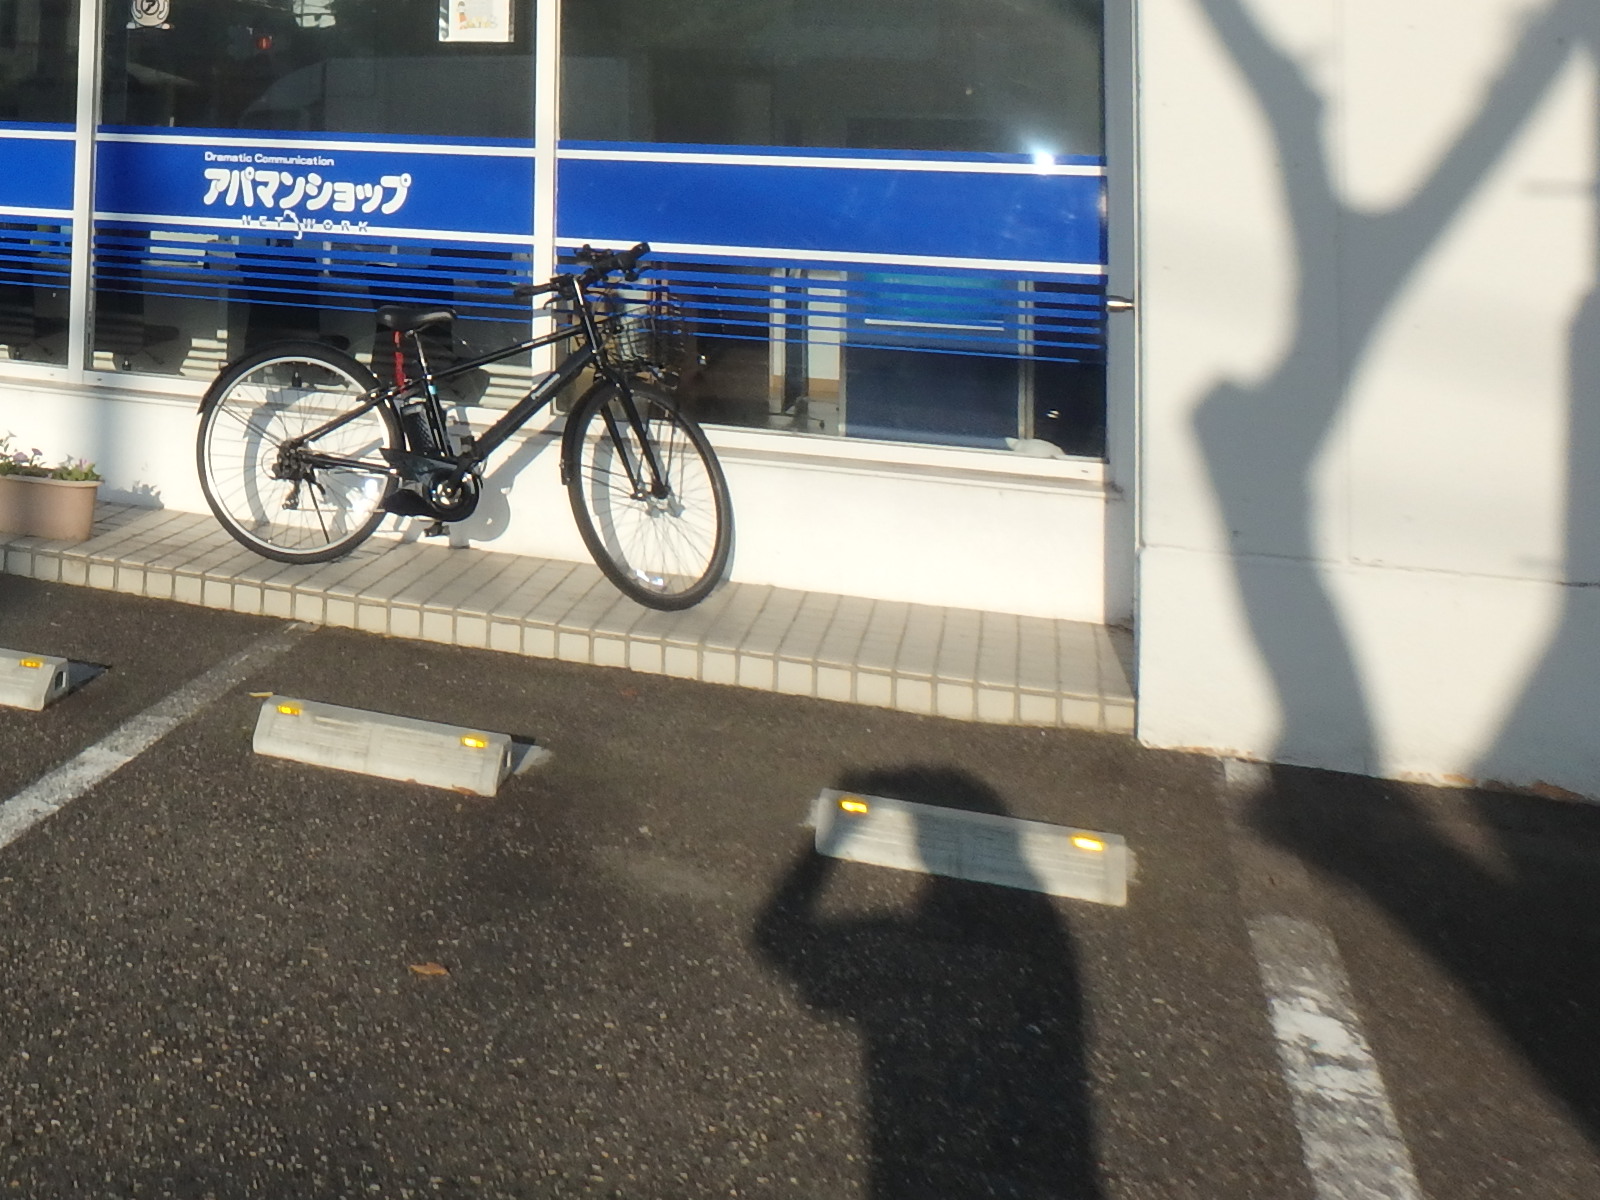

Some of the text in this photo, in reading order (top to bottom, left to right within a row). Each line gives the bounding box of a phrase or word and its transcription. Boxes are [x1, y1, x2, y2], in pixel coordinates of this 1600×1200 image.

[204, 151, 335, 166] Dramatic Communication
[203, 166, 412, 215] アパマンショップ
